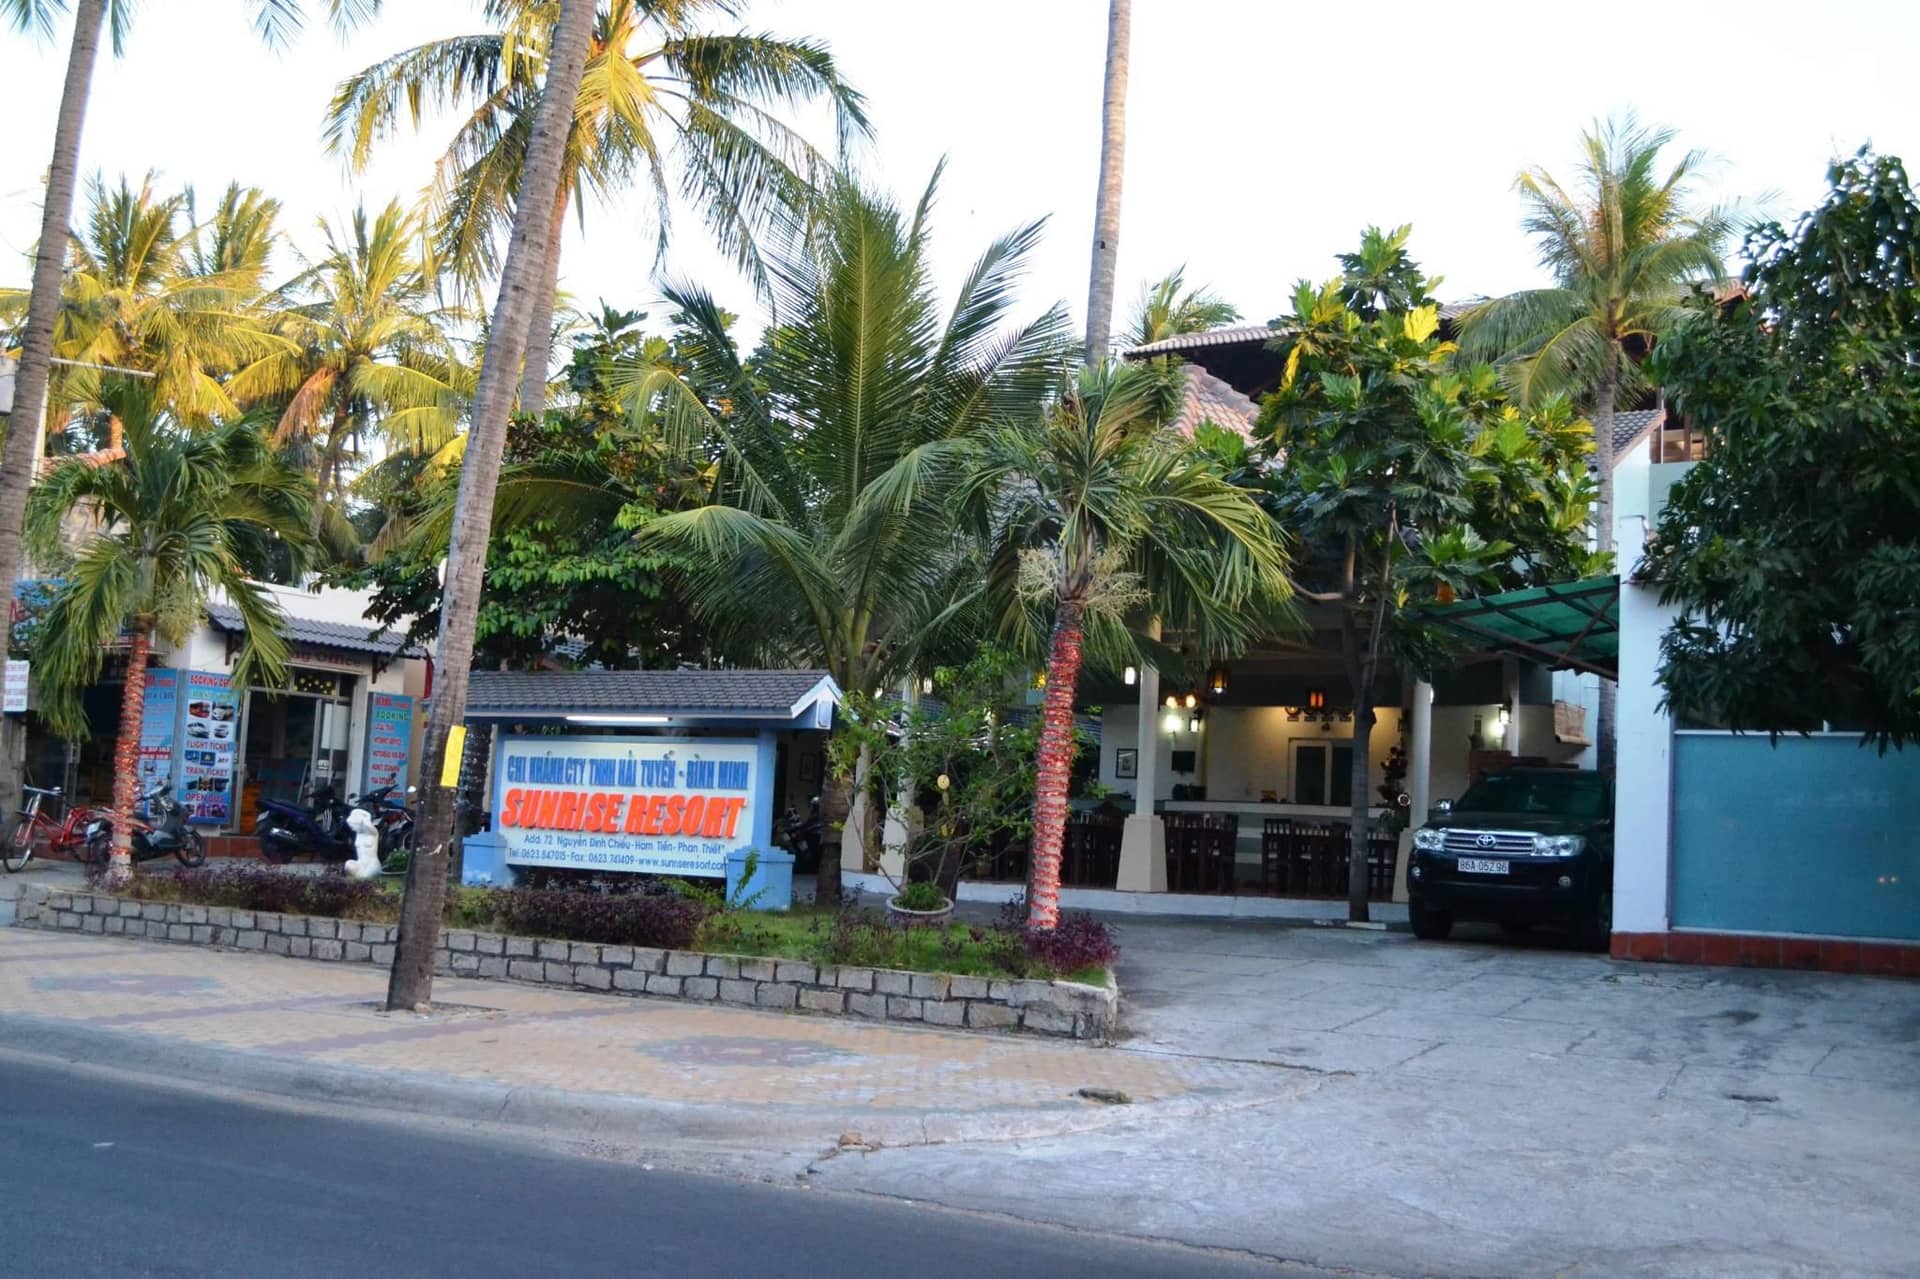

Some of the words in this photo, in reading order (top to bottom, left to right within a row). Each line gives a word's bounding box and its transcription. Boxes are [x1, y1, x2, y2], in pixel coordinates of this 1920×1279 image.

[508, 755, 527, 783] CHI
[566, 757, 587, 786] CTY
[718, 760, 749, 791] MINH
[501, 788, 625, 834] SUNRISE
[623, 794, 746, 840] RESORT
[678, 841, 698, 853] Phan
